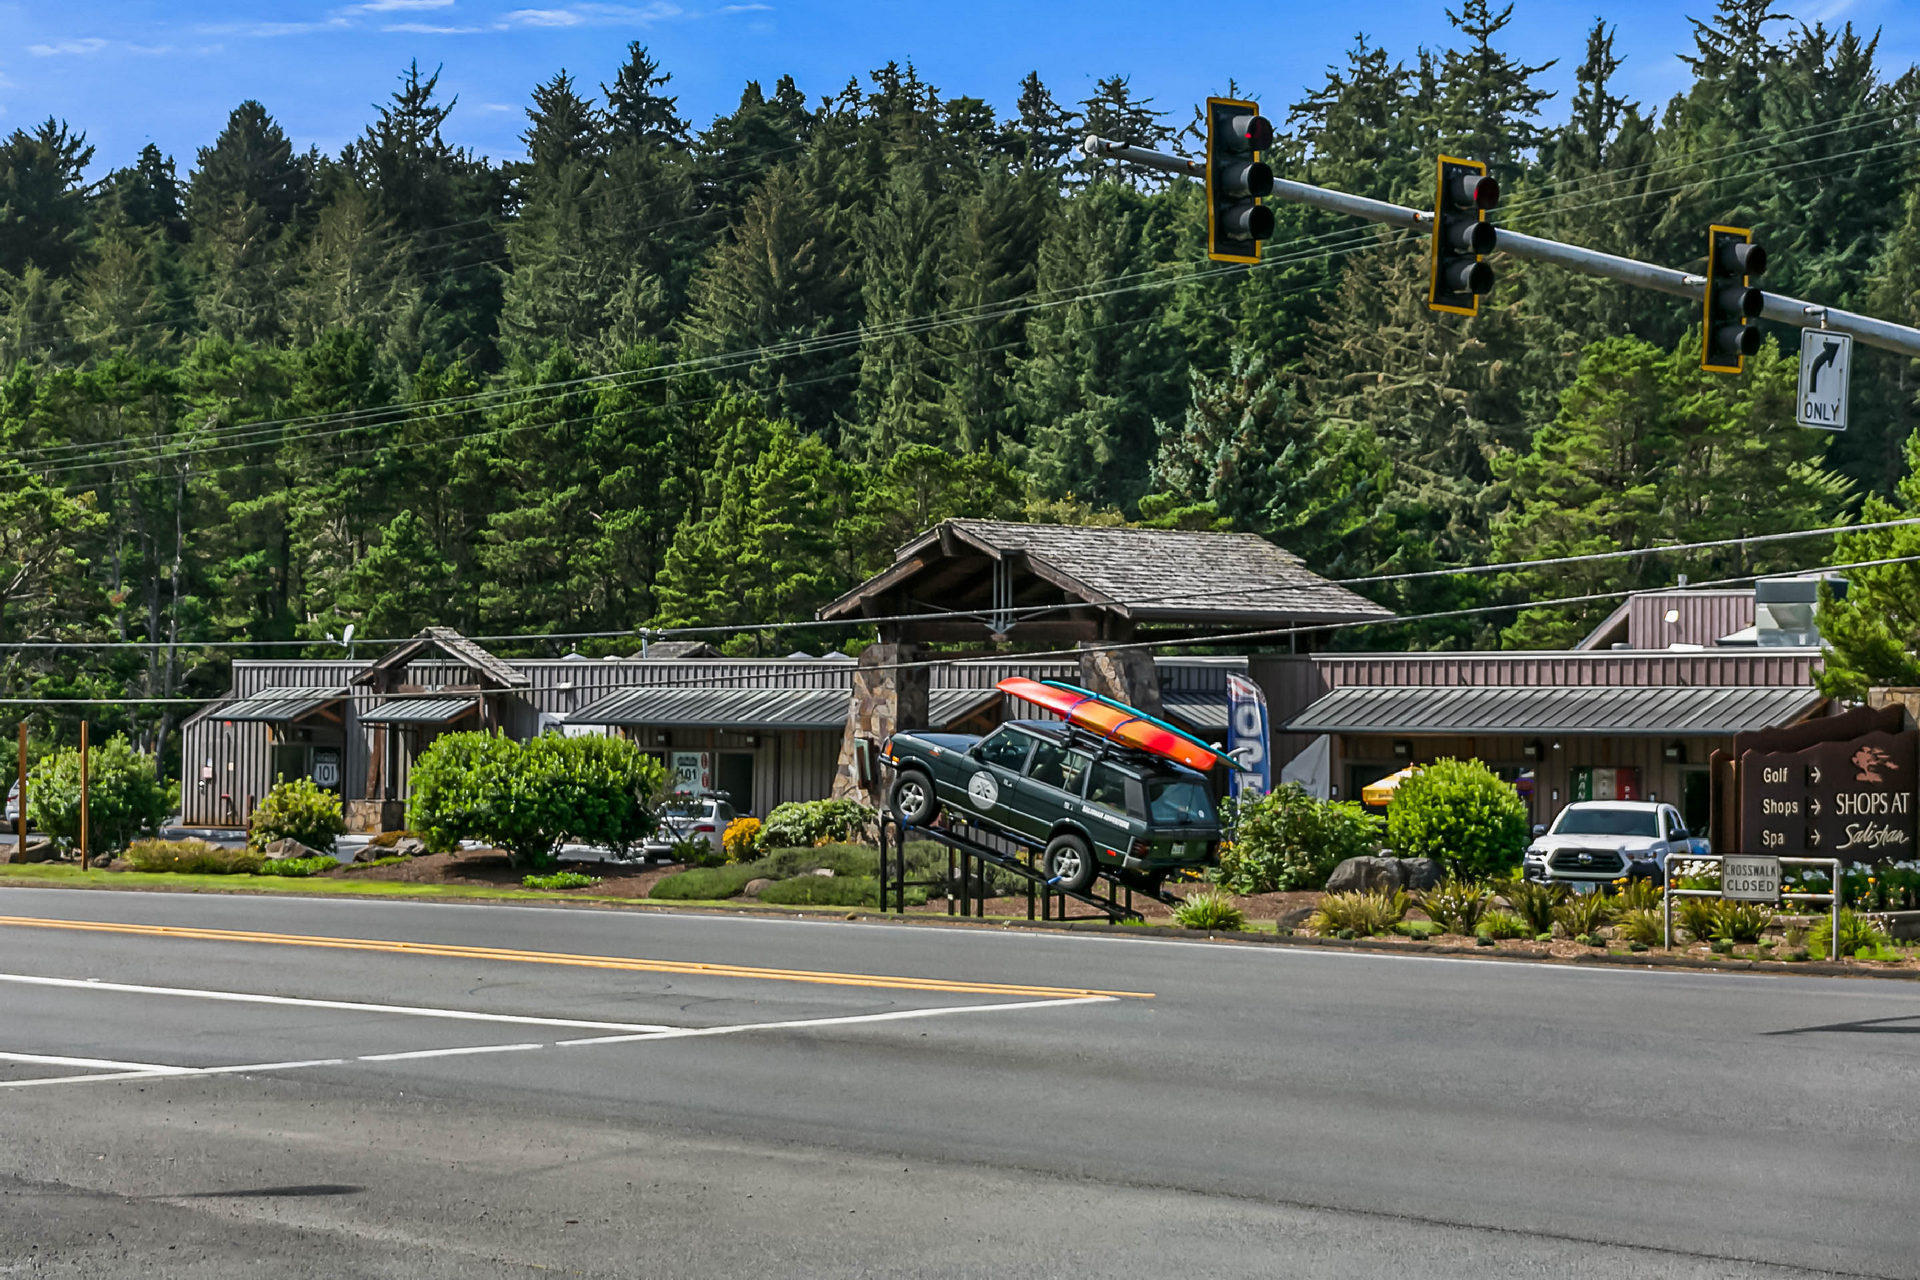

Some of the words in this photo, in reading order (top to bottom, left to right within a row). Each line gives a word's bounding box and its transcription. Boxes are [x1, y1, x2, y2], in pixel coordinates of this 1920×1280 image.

[1804, 401, 1840, 421] ONLY
[318, 765, 335, 781] 101
[1762, 767, 1788, 783] Golf
[1762, 799, 1799, 816] Shops
[1835, 792, 1888, 815] SHOPS
[1891, 792, 1910, 814] AT
[1762, 830, 1785, 848] Spa
[1836, 821, 1910, 849] Salishan
[1725, 864, 1777, 877] CROSSWALK
[1726, 879, 1775, 892] CLOSED
